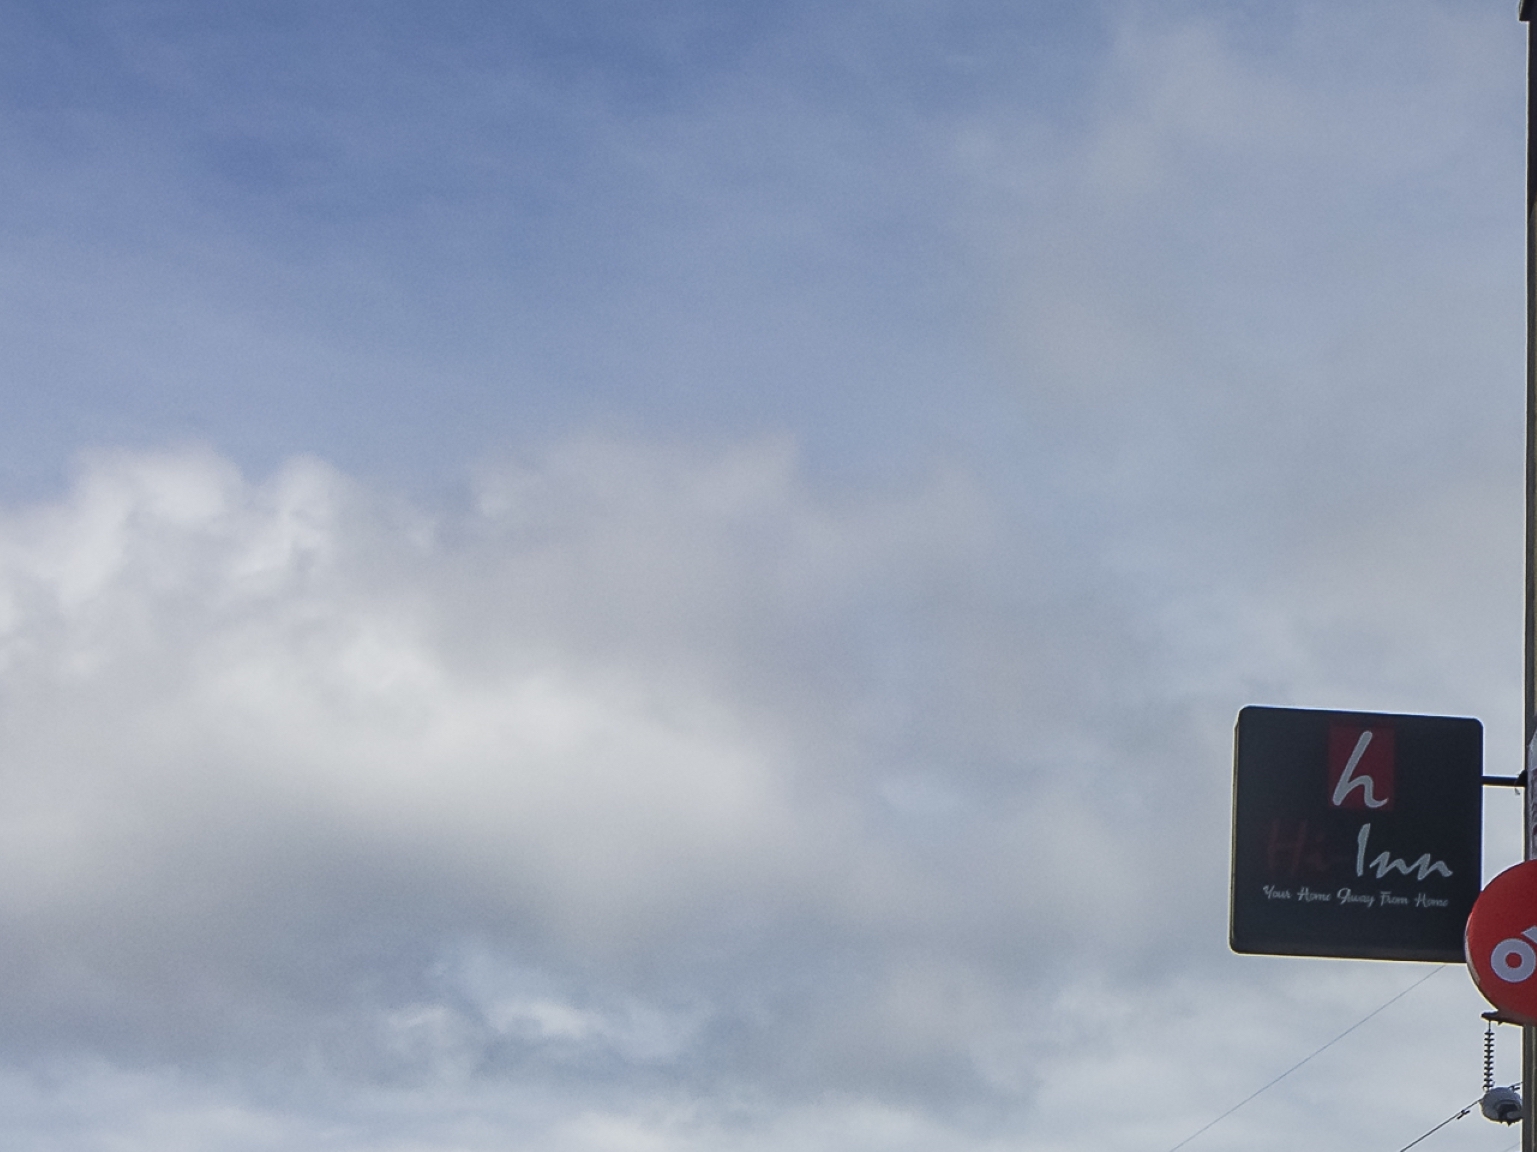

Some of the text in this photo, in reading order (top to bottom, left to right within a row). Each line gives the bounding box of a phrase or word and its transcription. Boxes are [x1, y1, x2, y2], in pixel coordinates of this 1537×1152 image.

[1263, 885, 1292, 900] Your
[1297, 886, 1333, 902] Home
[1380, 890, 1409, 907] From
[1414, 892, 1449, 908] Home
